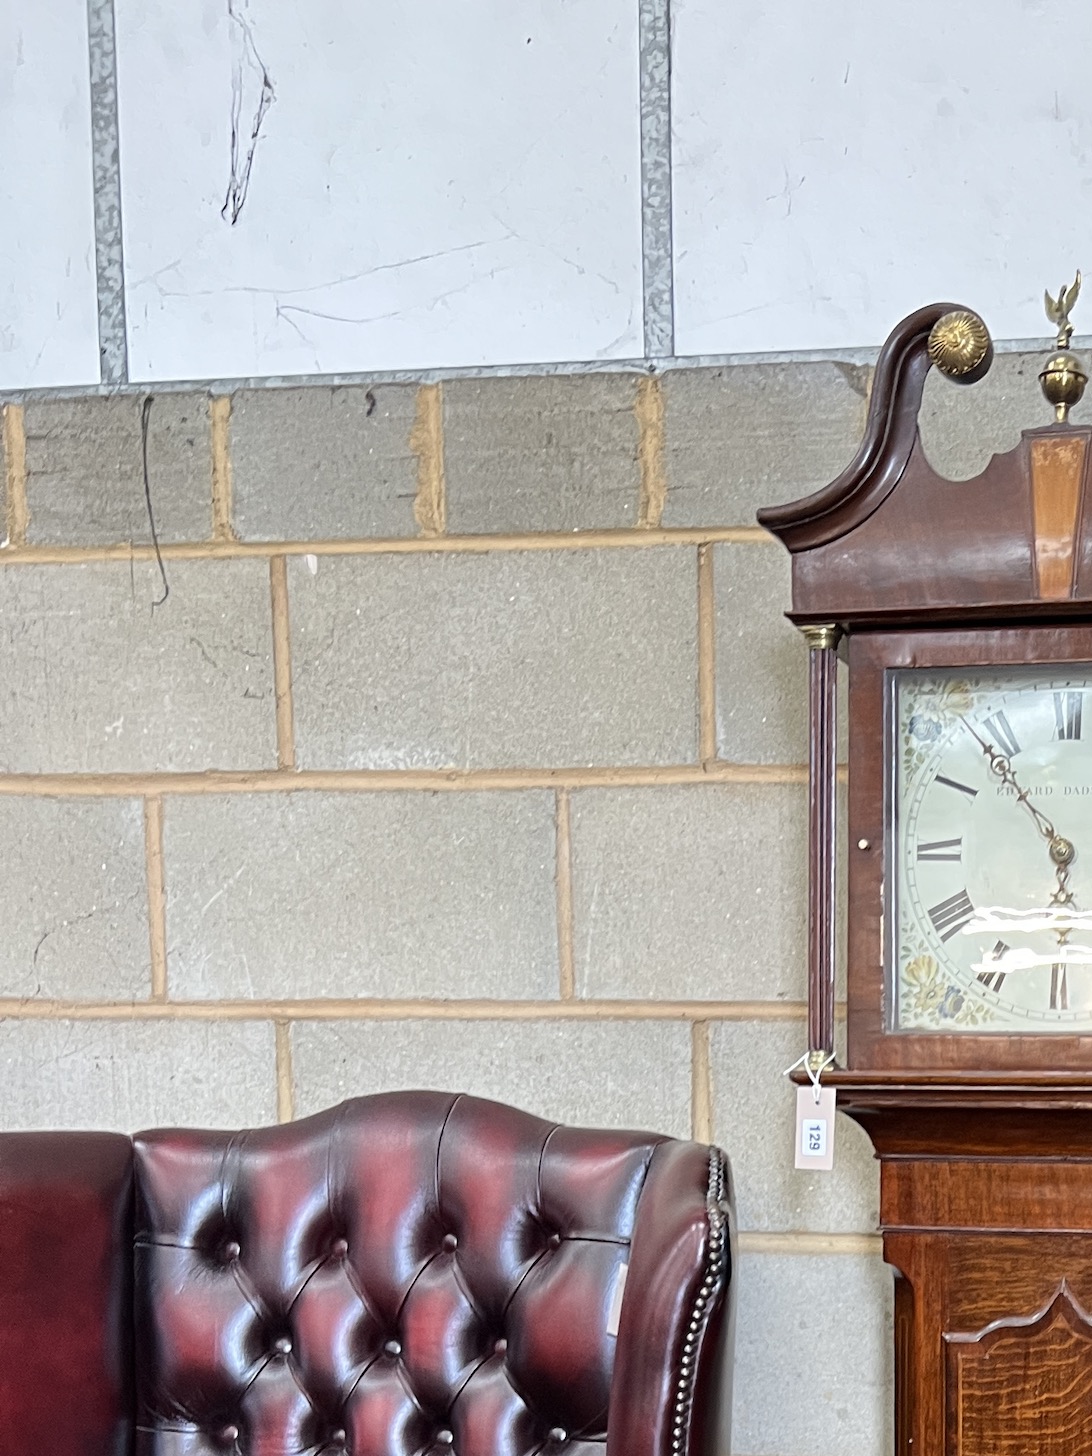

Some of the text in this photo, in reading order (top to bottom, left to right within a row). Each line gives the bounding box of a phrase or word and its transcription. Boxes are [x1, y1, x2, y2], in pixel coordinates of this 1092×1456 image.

[1050, 691, 1084, 741] XII
[934, 766, 980, 807] X
[916, 836, 963, 863] IX
[927, 886, 975, 944] VIII
[808, 1124, 821, 1151] 129
